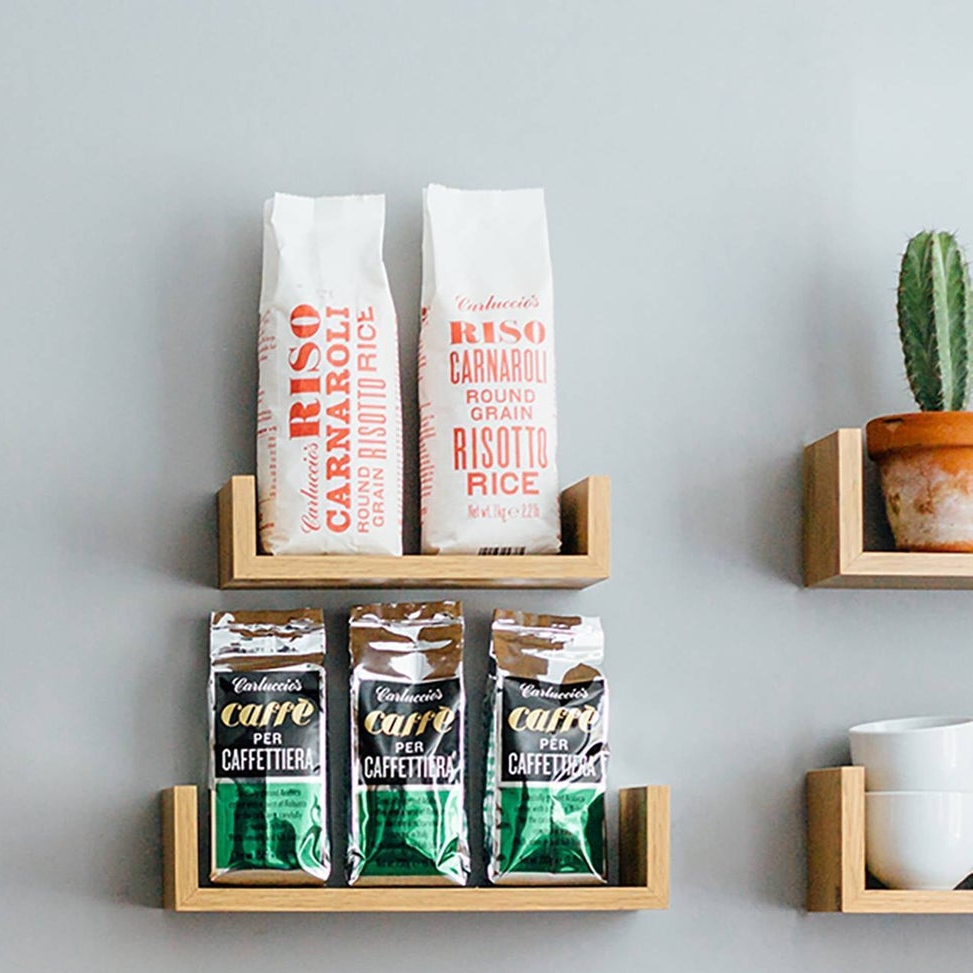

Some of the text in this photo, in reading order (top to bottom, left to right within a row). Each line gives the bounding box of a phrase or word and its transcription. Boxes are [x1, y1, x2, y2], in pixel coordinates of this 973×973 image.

[455, 294, 539, 312] Carluccio's
[356, 305, 377, 372] RICE
[449, 319, 546, 345] RISO
[289, 304, 321, 439] RISO
[449, 348, 547, 385] CARNAROLI
[465, 388, 536, 404] ROUND
[326, 305, 351, 533] CARNAROLI
[357, 379, 387, 459] RISOTTO
[470, 405, 533, 421] GRAIN
[453, 425, 548, 471] RISOTTO
[300, 442, 320, 533] Carluccio's
[467, 471, 539, 496] RICE
[357, 466, 370, 533] ROUND
[372, 467, 385, 527] GRAIN
[232, 676, 303, 694] Carluccio's
[375, 685, 444, 703] Carluccio's
[519, 682, 589, 699] Carluccio's
[221, 697, 315, 727] caffè
[364, 705, 455, 738] caffè
[253, 732, 283, 745] PER
[395, 741, 424, 754] PER
[539, 738, 569, 751] PER
[221, 747, 314, 771] CAFFETTIERA
[364, 755, 455, 779] CAFFETTIERA
